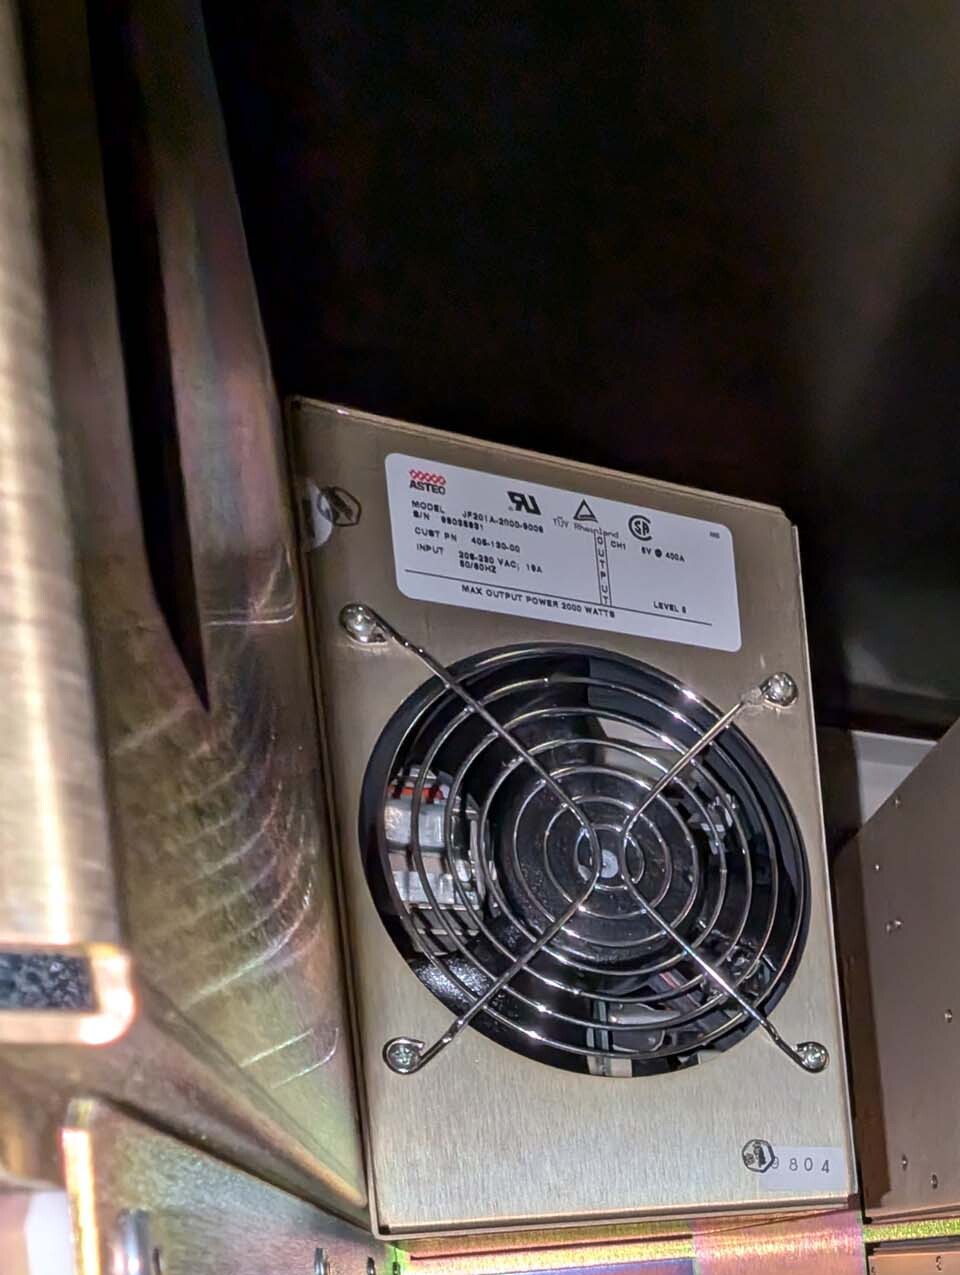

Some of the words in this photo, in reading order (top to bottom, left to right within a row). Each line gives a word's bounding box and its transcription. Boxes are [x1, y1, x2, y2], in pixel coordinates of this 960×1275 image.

[411, 500, 445, 514] MODEL
[462, 585, 482, 596] MAX
[486, 589, 523, 602] OUTPUT
[526, 595, 559, 608] POWER
[561, 602, 582, 612] 2000
[584, 607, 615, 619] WATTS
[653, 600, 679, 613] LEVEL
